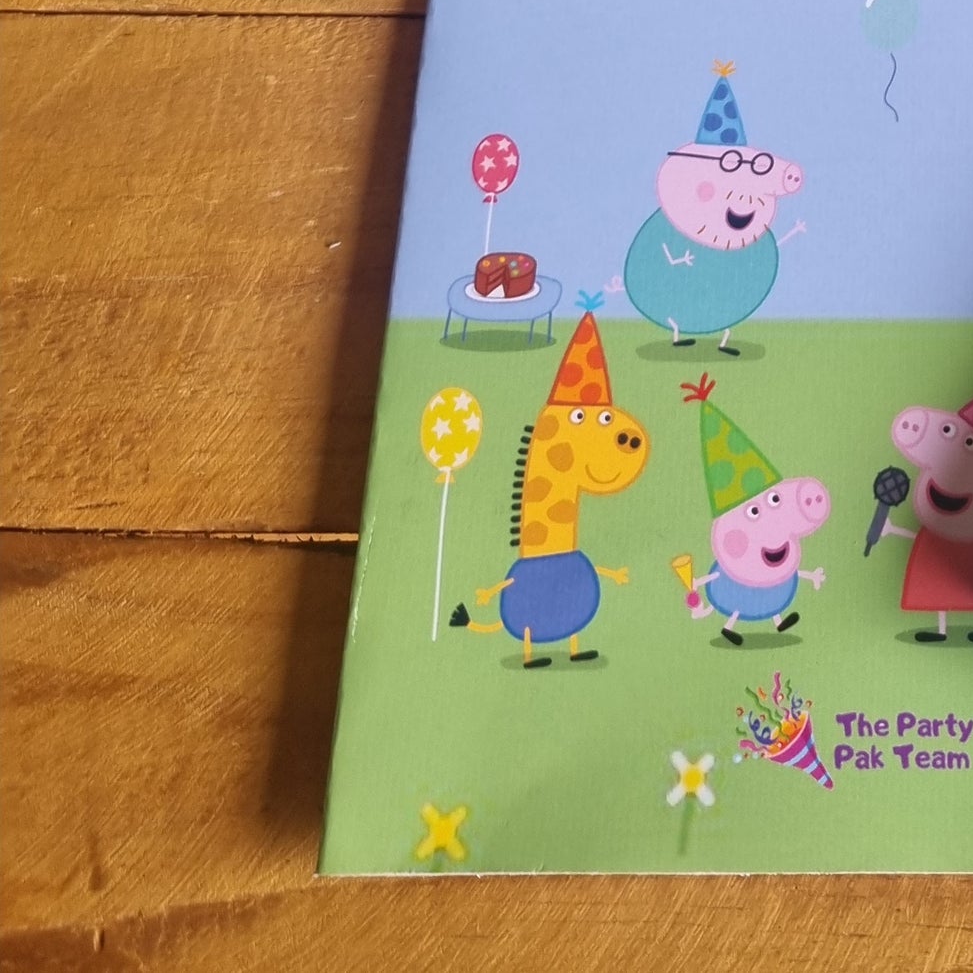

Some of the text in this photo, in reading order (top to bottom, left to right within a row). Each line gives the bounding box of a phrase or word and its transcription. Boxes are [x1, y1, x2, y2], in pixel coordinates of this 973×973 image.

[835, 712, 890, 737] The
[833, 743, 971, 770] Pak Team
